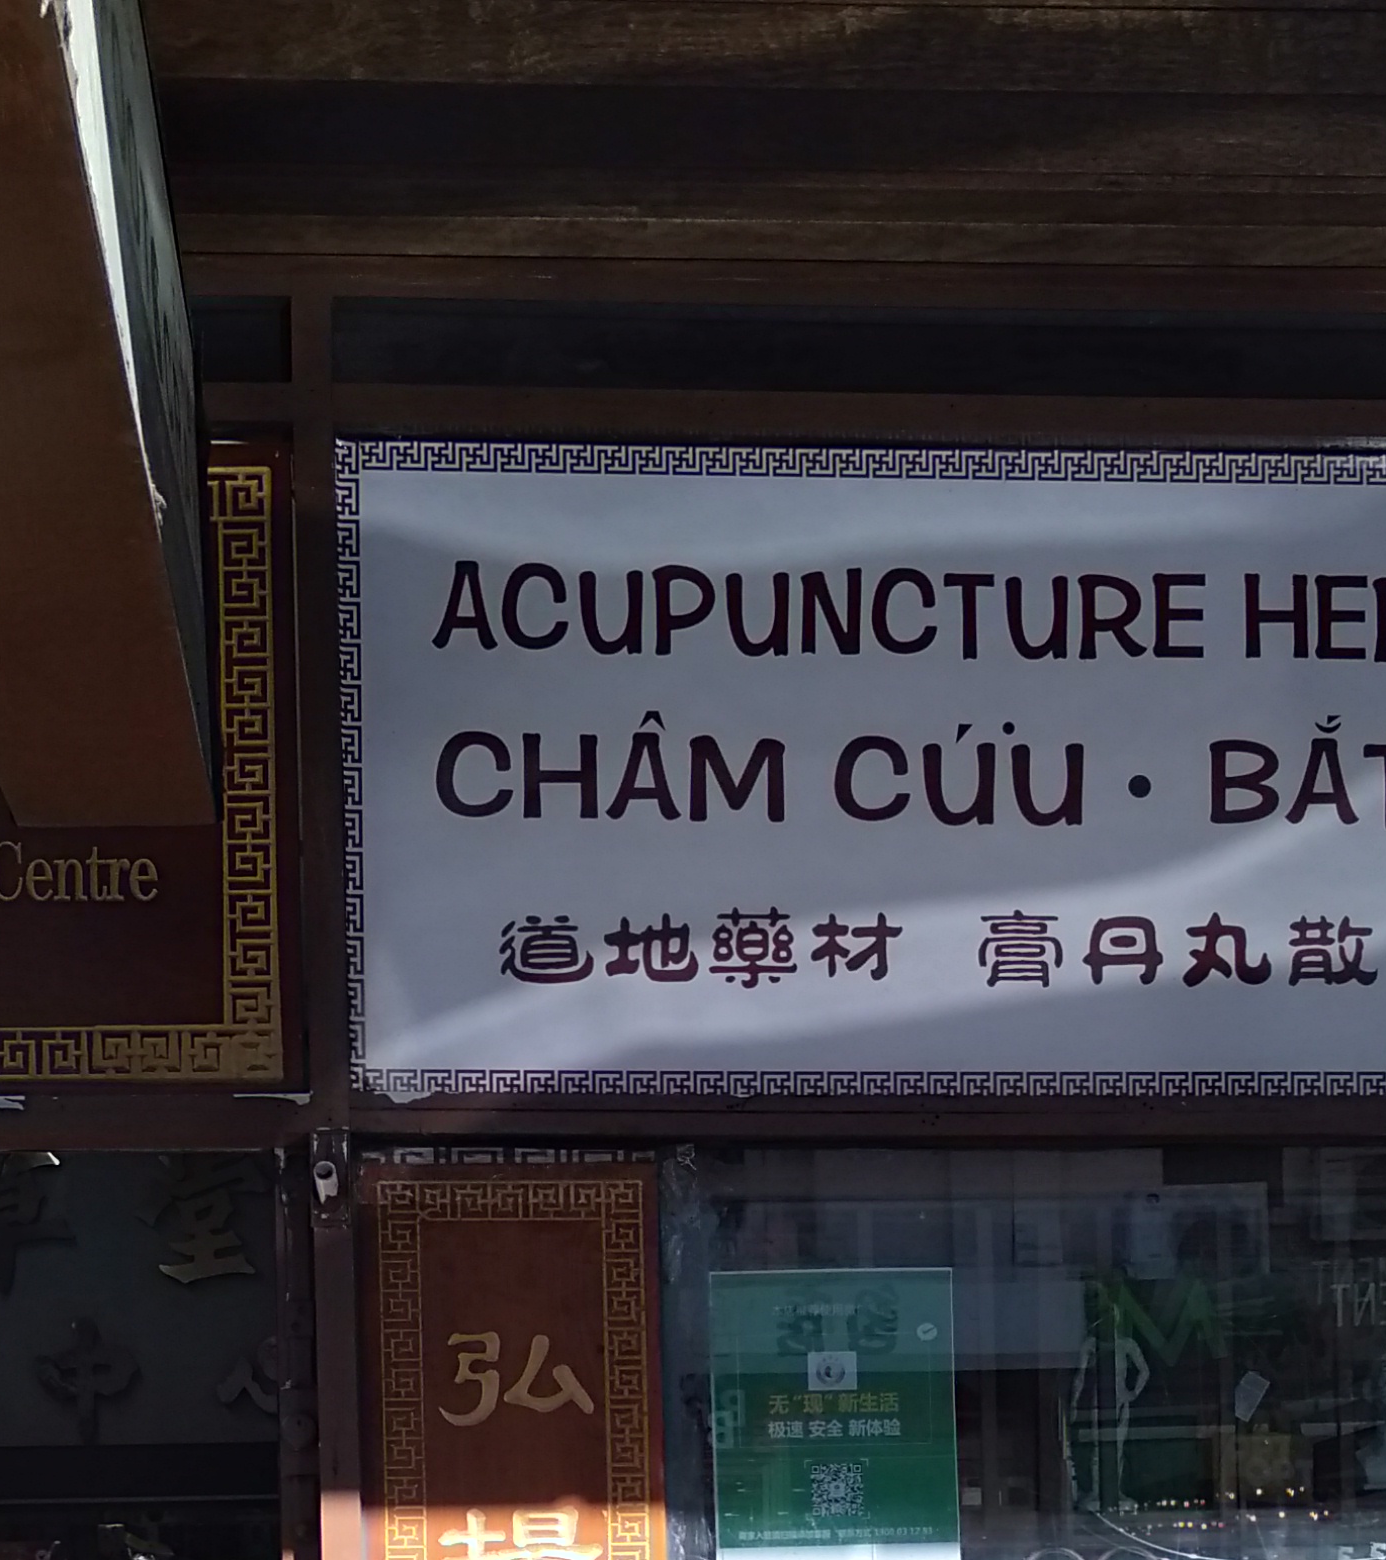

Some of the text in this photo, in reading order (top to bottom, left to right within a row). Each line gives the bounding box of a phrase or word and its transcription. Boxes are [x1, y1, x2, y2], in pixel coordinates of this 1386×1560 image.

[432, 559, 1207, 661] ACUPUNCTURE
[435, 709, 786, 824] CHÂM
[500, 906, 903, 990] 道地藥材
[978, 909, 1378, 989] 膏丹丸散
[768, 1419, 804, 1440] 极速
[808, 1419, 844, 1438] 安全
